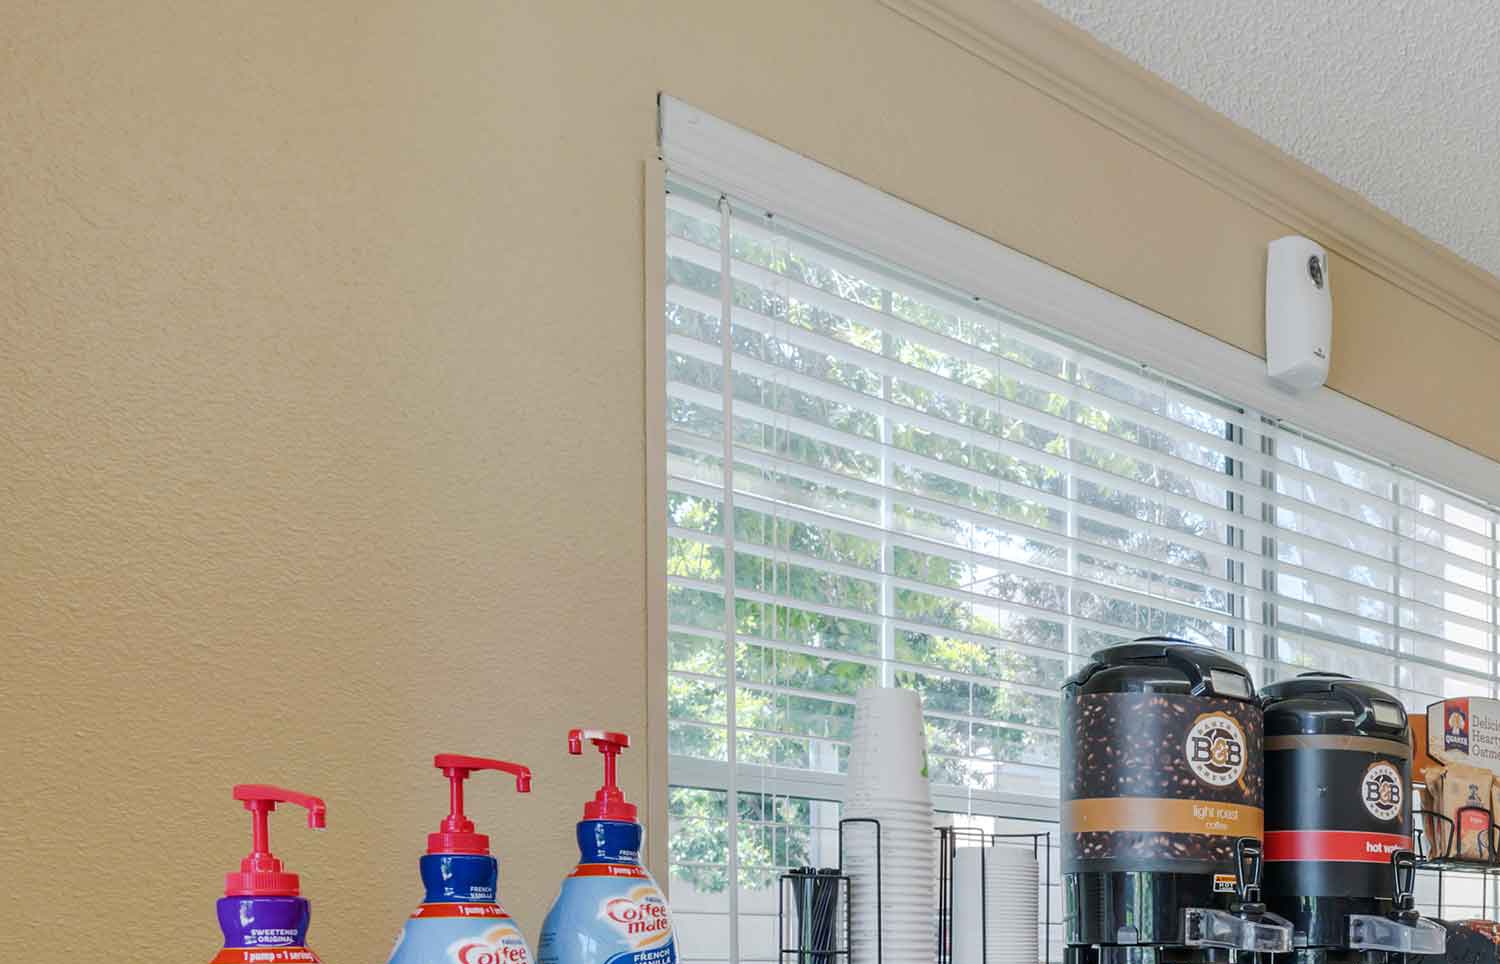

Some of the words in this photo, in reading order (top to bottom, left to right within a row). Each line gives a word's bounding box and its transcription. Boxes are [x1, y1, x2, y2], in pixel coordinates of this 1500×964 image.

[1445, 734, 1468, 746] QUAKER
[1191, 736, 1242, 767] B&B
[1366, 781, 1400, 804] B&B
[1193, 805, 1214, 819] light
[1366, 841, 1382, 853] hot
[607, 898, 668, 923] Coffee
[251, 929, 299, 937] SWEETENED
[628, 919, 668, 934] mate
[258, 935, 295, 944] ORIGINAL
[243, 951, 249, 961] 1
[249, 952, 276, 963] pump
[634, 949, 671, 963] FRENCH
